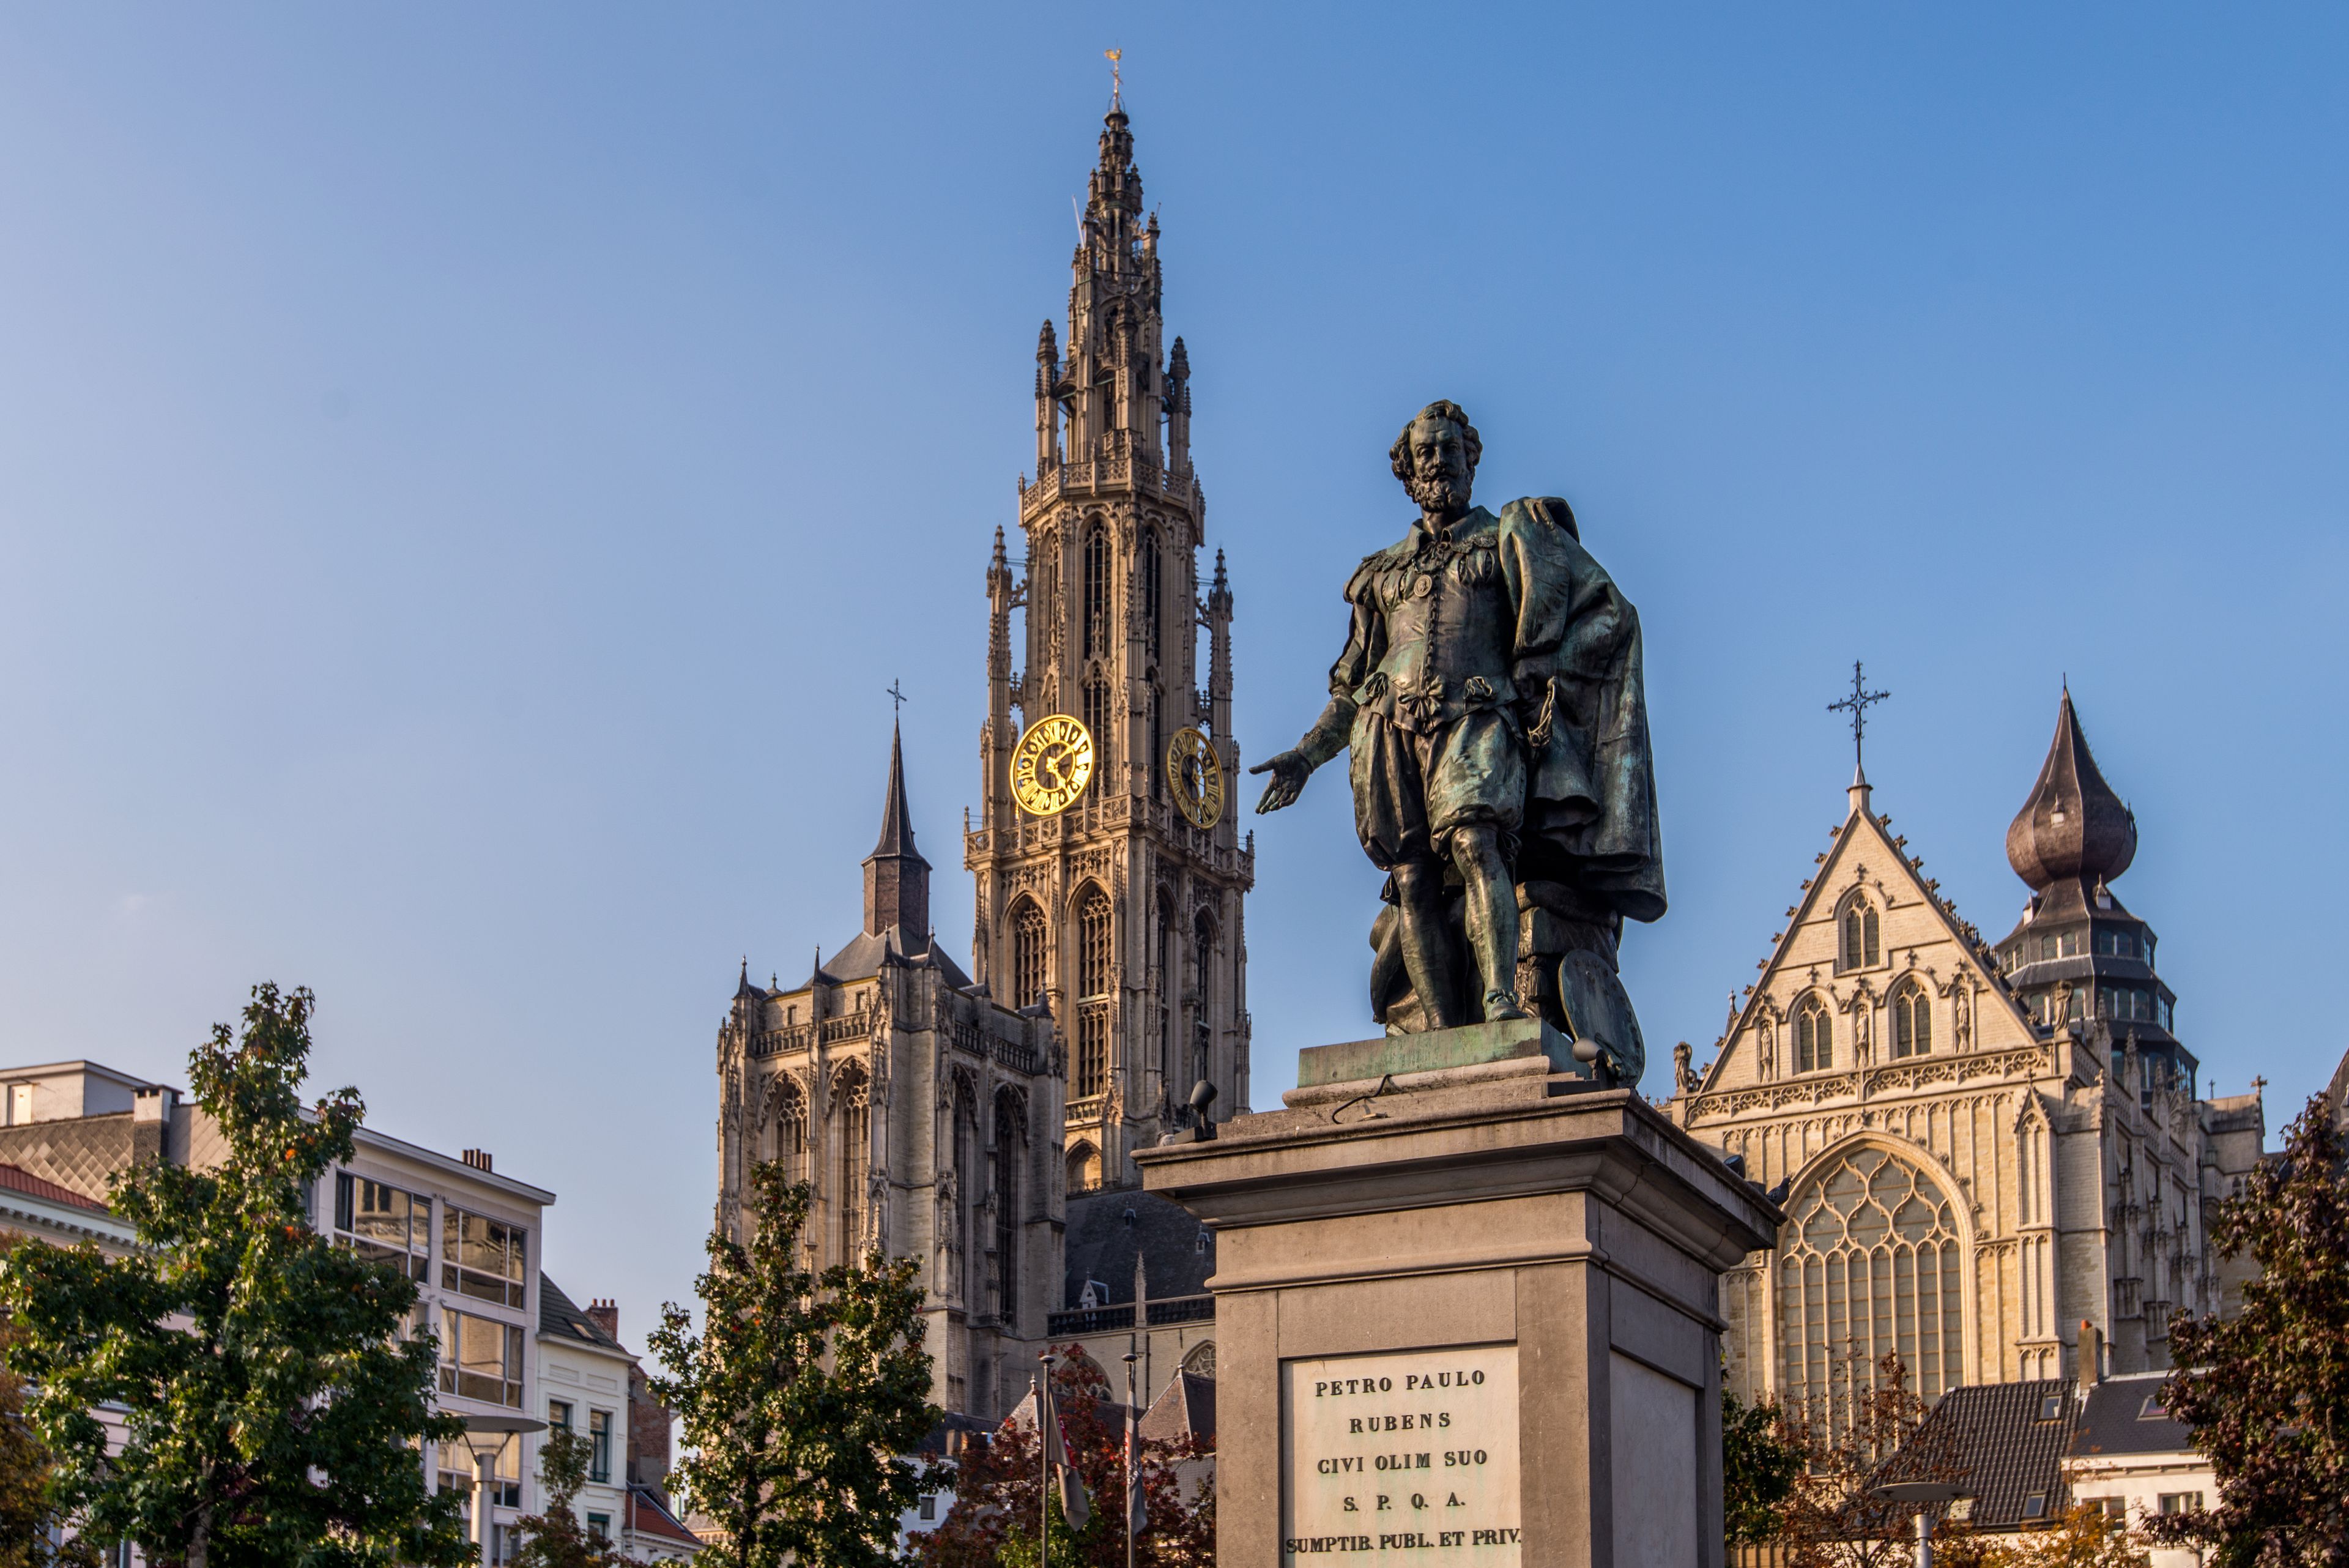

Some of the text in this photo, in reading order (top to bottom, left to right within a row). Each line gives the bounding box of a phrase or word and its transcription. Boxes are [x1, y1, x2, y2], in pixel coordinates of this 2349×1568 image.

[1315, 1370, 1485, 1397] PETRO PAULO
[1349, 1412, 1450, 1433] RUBENS
[1317, 1449, 1487, 1474] CIVI OLIM SUO
[1343, 1492, 1466, 1512] S. P. Q. A.
[1286, 1528, 1521, 1553] SUMPTIB. PUBL. ET PRIV.
